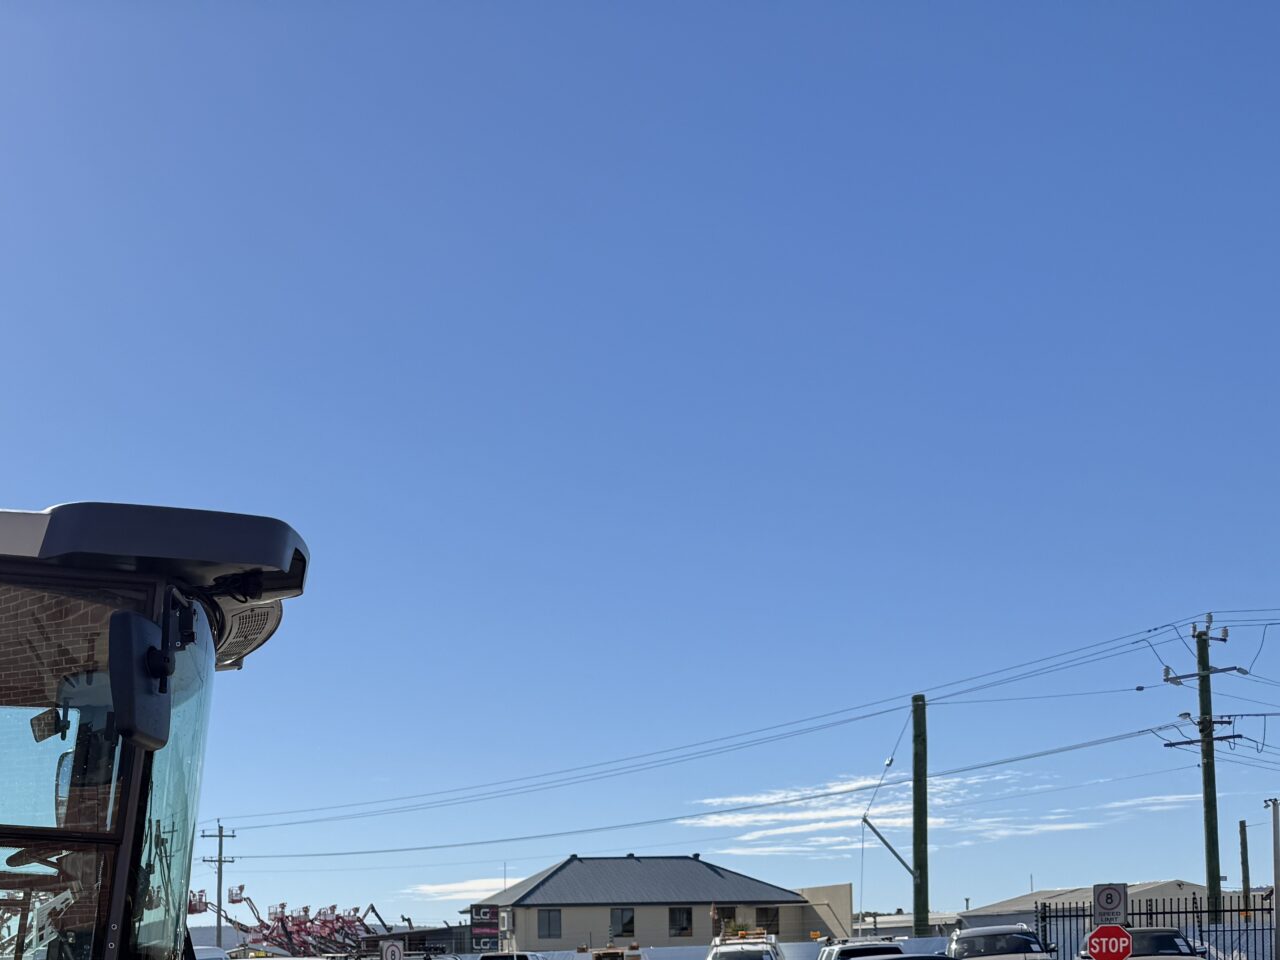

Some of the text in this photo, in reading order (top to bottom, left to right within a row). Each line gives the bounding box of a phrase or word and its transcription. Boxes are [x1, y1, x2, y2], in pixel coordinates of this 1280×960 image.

[1105, 893, 1113, 904] 8
[1090, 938, 1129, 953] STOP
[390, 950, 396, 960] 8
